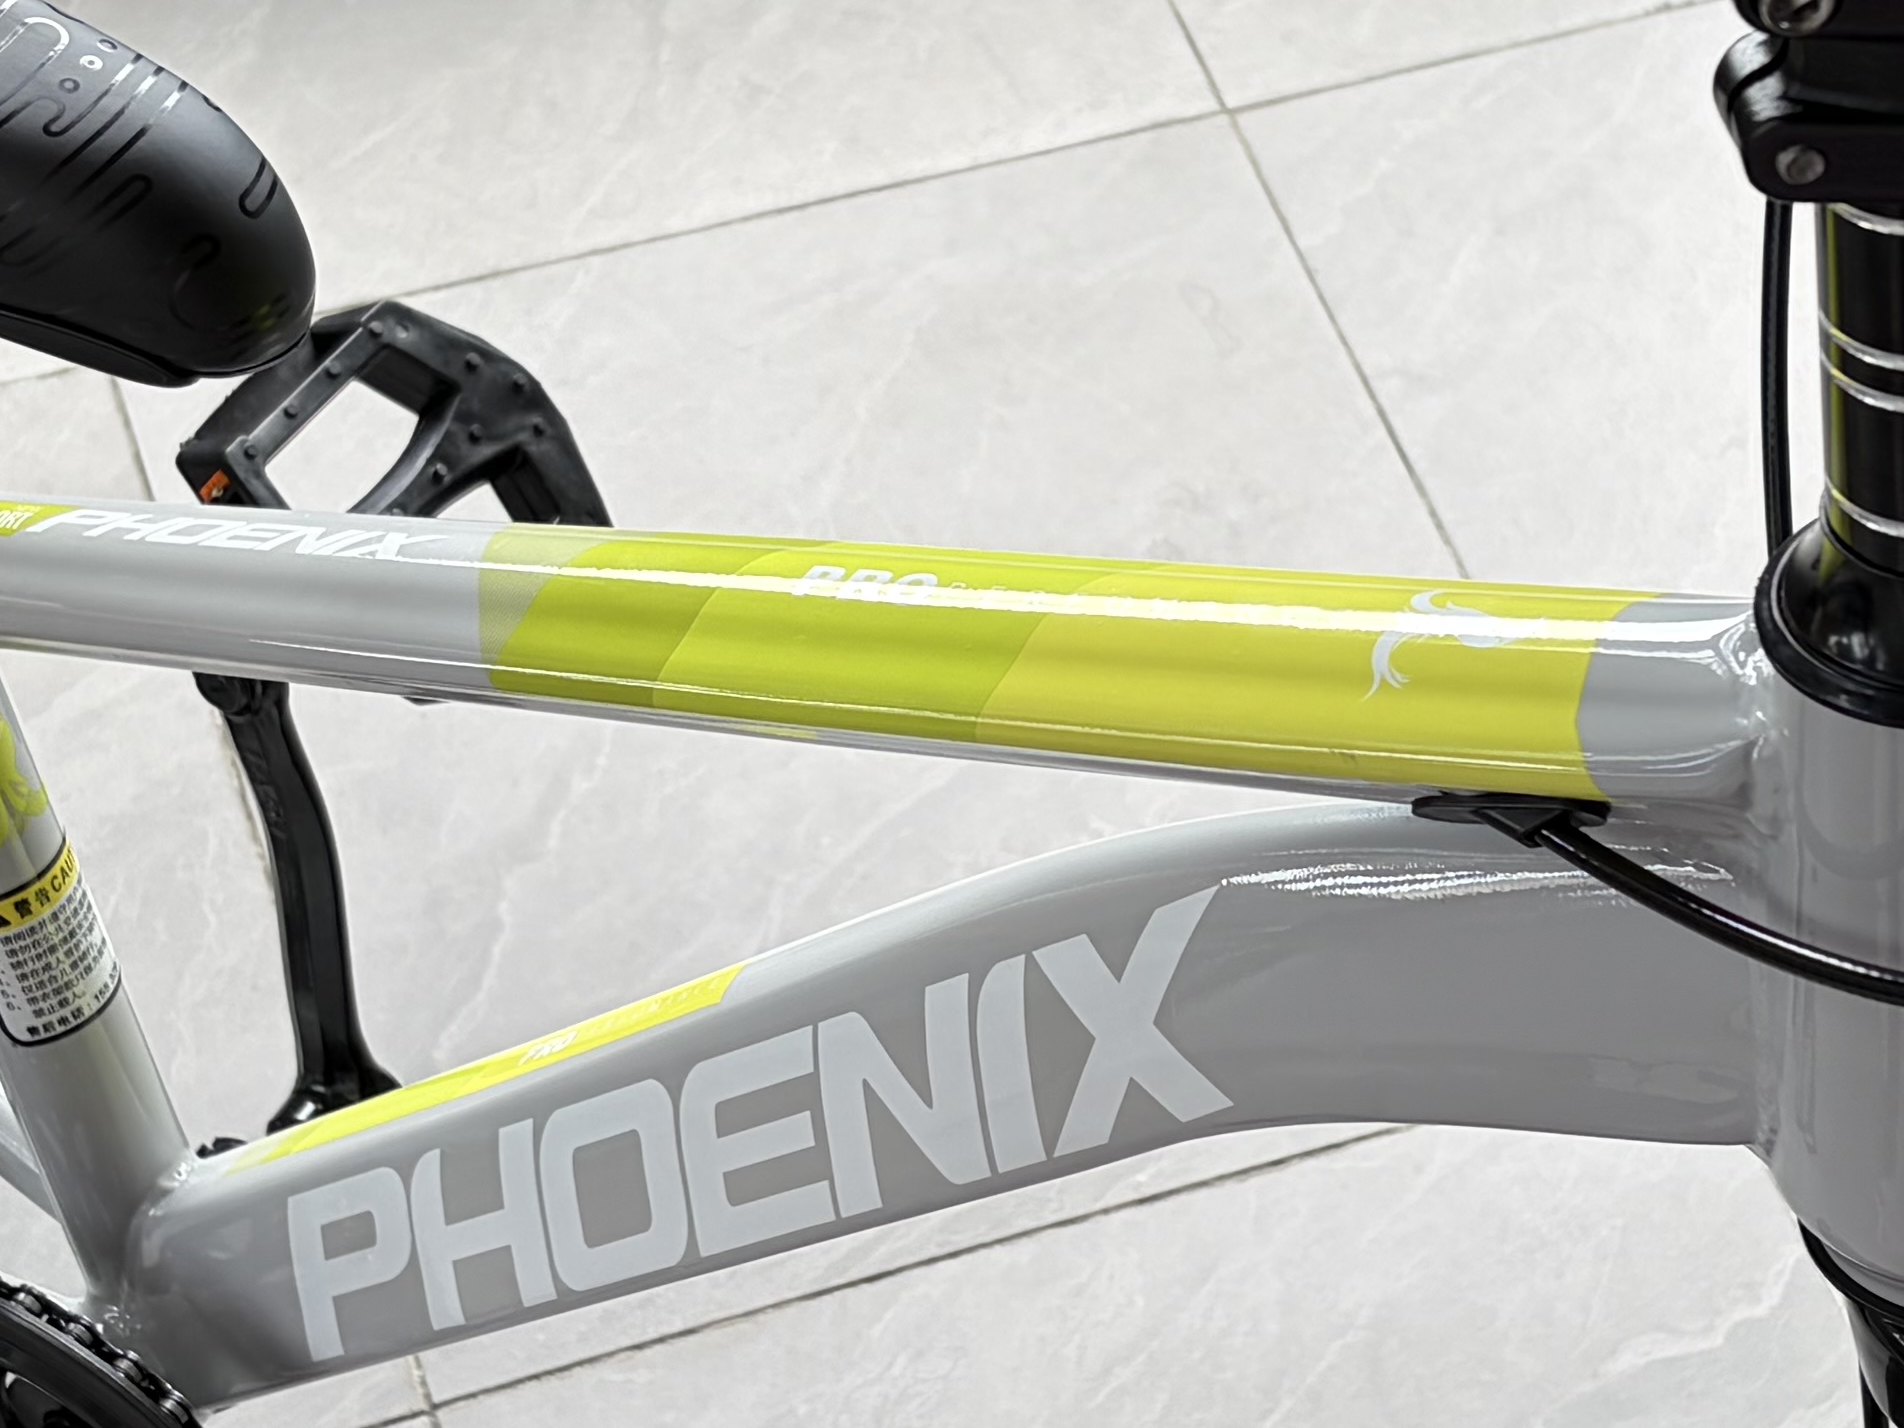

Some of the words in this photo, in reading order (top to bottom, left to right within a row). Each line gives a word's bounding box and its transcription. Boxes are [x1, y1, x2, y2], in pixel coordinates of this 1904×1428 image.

[24, 507, 451, 560] PHOENIX
[13, 886, 51, 920] 警告
[286, 884, 1234, 1362] PHOENIX
